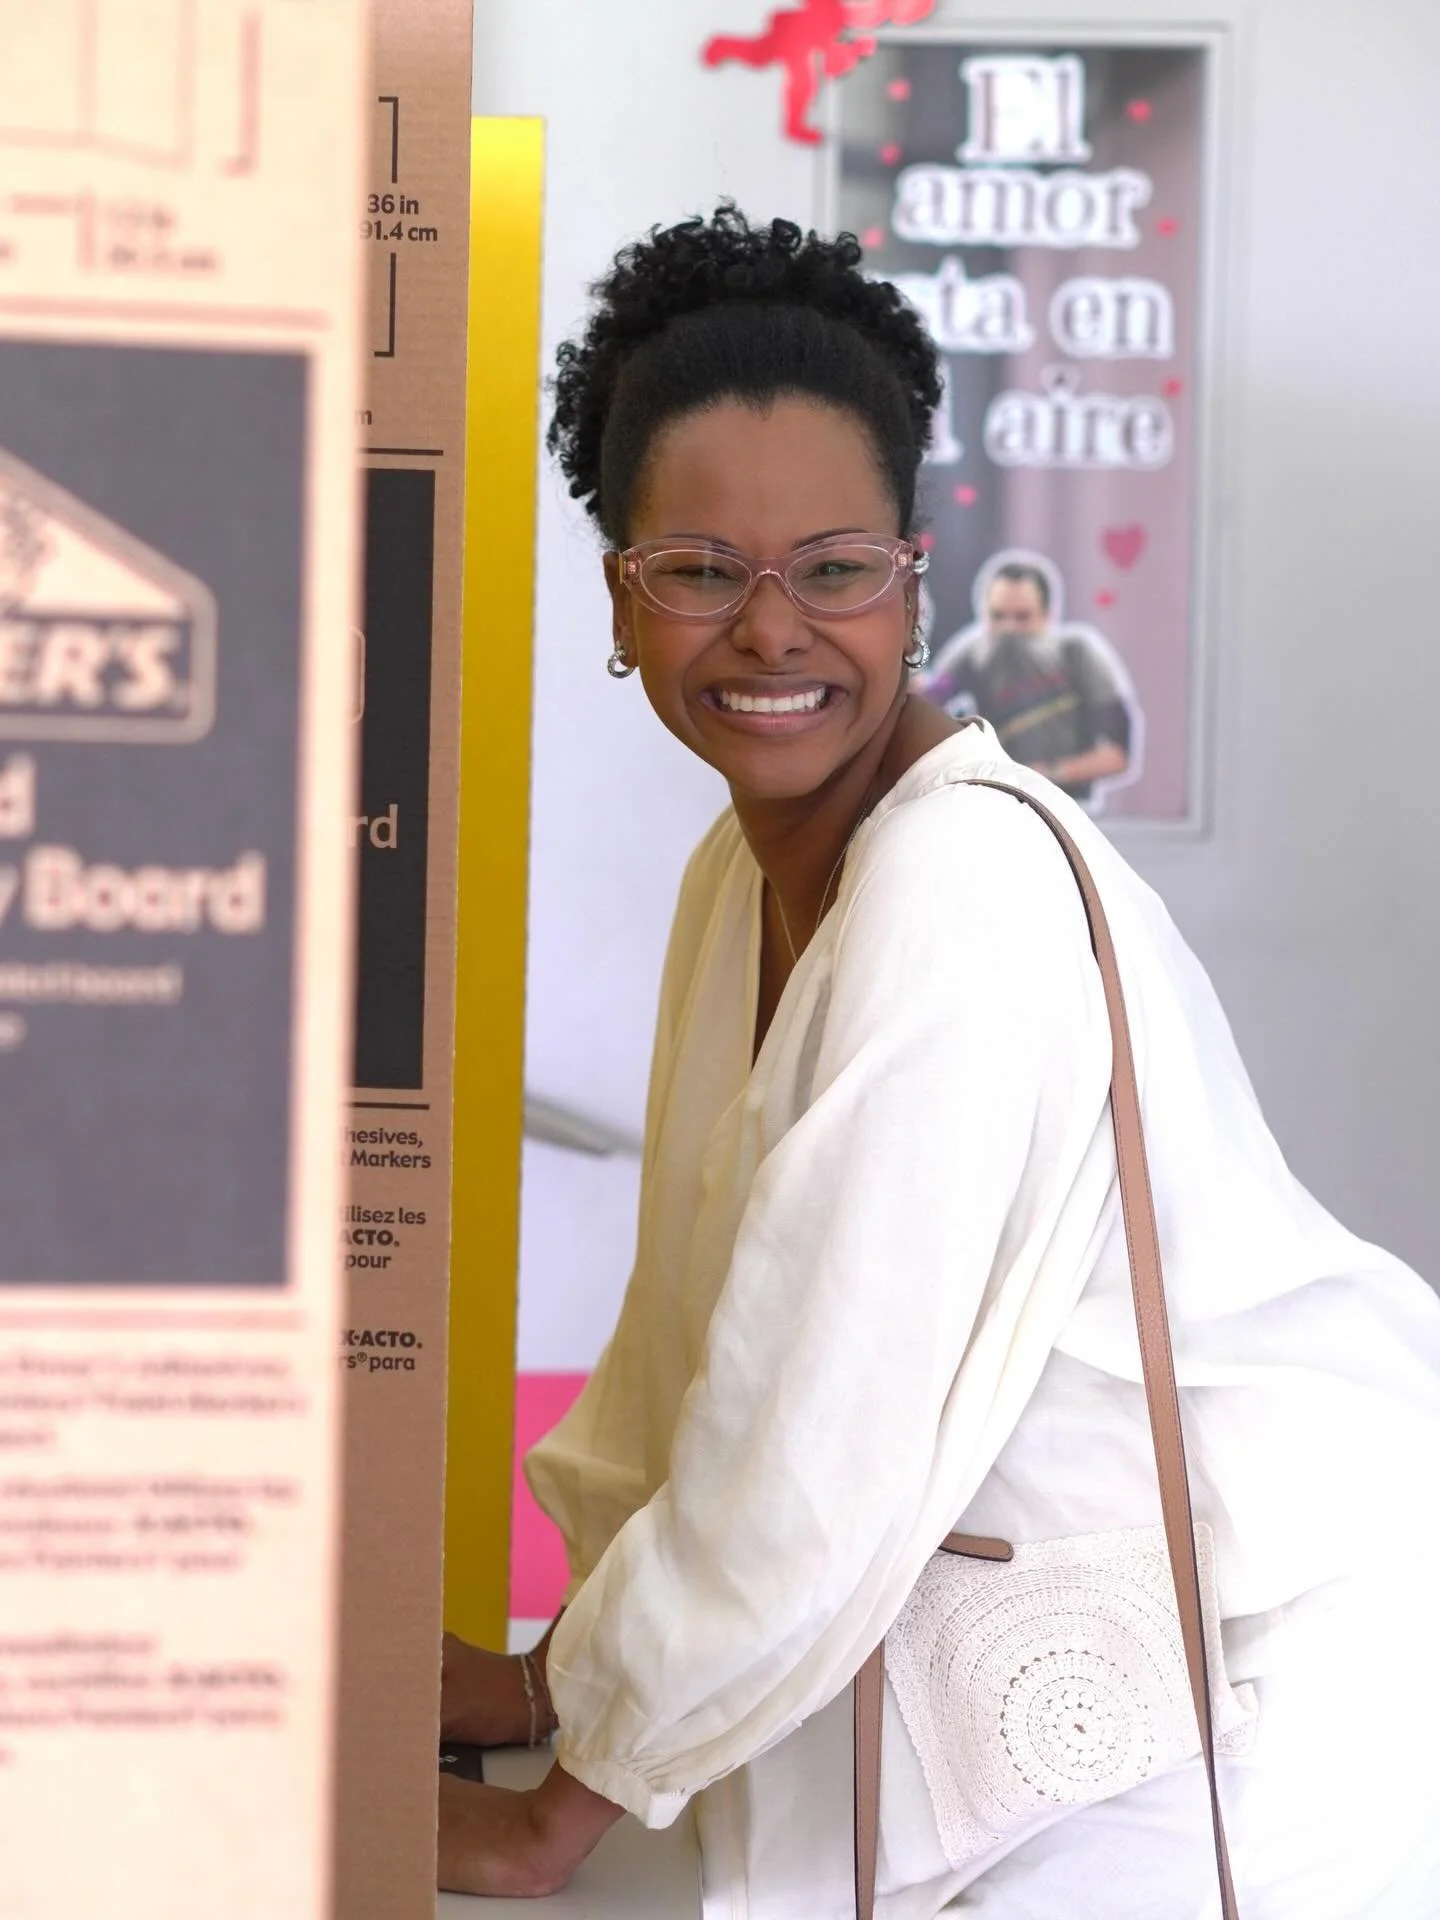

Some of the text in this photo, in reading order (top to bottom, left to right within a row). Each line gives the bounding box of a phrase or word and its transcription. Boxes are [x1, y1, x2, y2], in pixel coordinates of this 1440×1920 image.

[367, 194, 419, 215] 36 in
[892, 163, 1152, 249] amor
[359, 220, 438, 242] 91.4 cm
[1048, 276, 1176, 360] en
[984, 363, 1175, 471] aire
[24, 845, 268, 934] Board
[350, 1148, 432, 1168] Markers
[398, 1206, 428, 1225] les
[345, 1254, 392, 1272] pour
[368, 1355, 416, 1373] para
